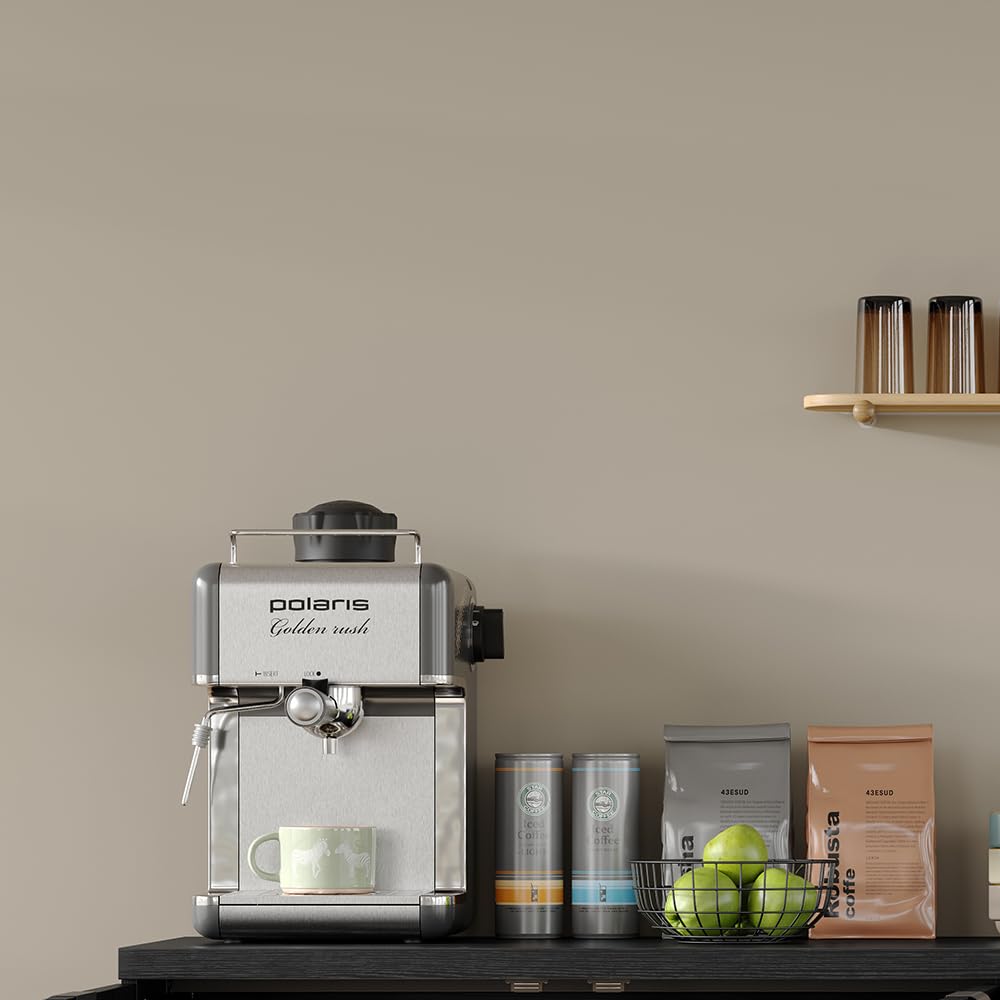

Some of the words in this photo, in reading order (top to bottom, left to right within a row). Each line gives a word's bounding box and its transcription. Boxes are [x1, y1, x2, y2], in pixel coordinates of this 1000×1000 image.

[270, 597, 369, 613] polaris
[270, 617, 327, 638] Golden
[332, 617, 371, 635] rush
[843, 868, 856, 918] coffe
